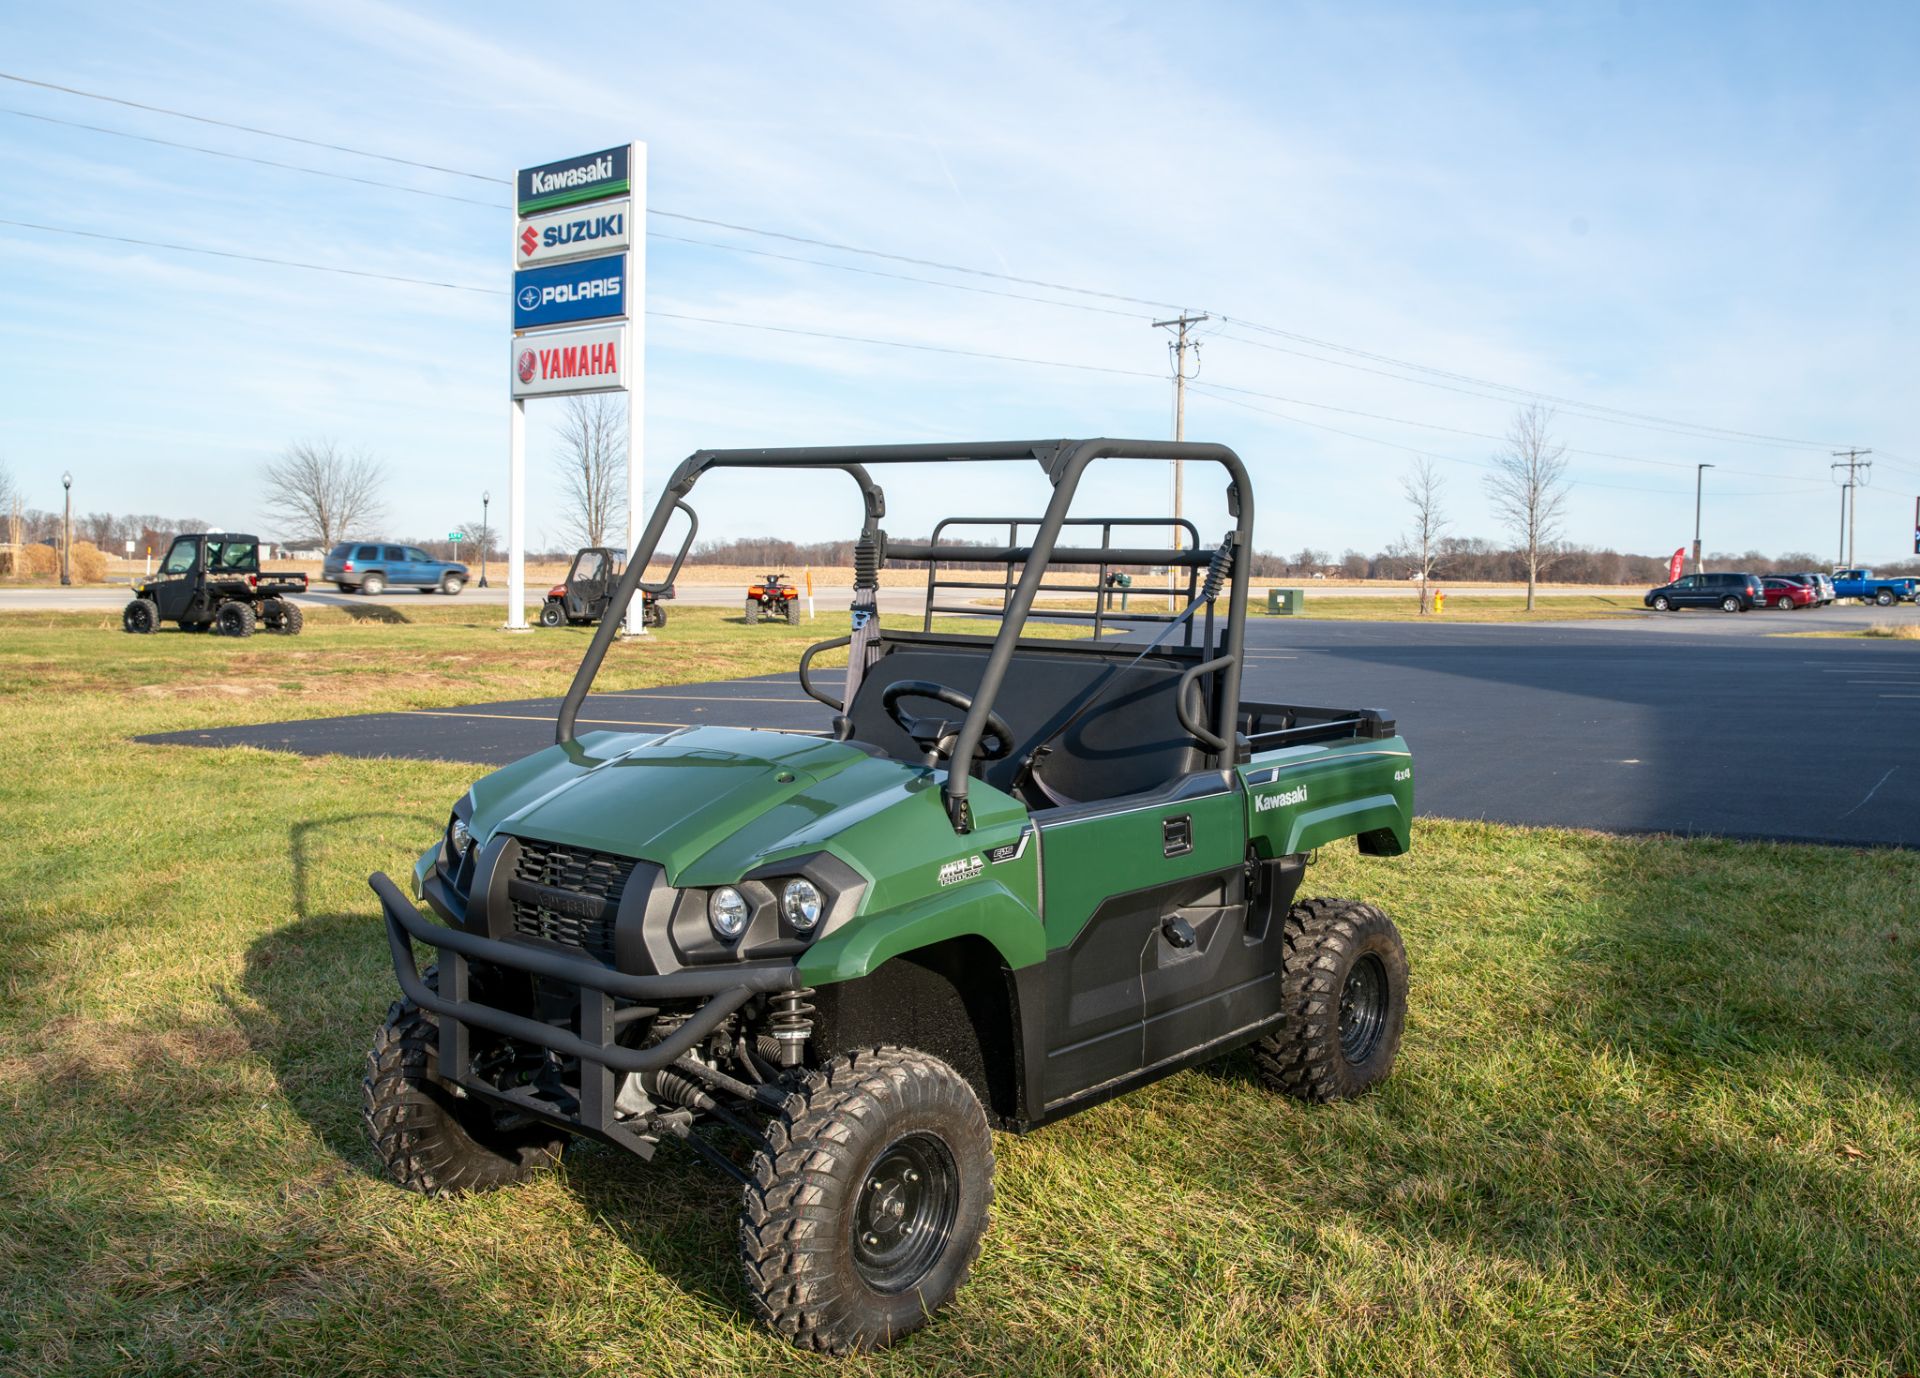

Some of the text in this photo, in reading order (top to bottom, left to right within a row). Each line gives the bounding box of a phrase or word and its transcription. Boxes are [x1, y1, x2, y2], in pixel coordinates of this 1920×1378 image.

[532, 155, 613, 195] Kawasaki
[543, 213, 623, 248] SUZUKI
[542, 276, 621, 305] POLARIS
[539, 342, 617, 380] YAMAHA
[1394, 768, 1411, 781] 4x4
[1254, 784, 1308, 813] Kawasaki
